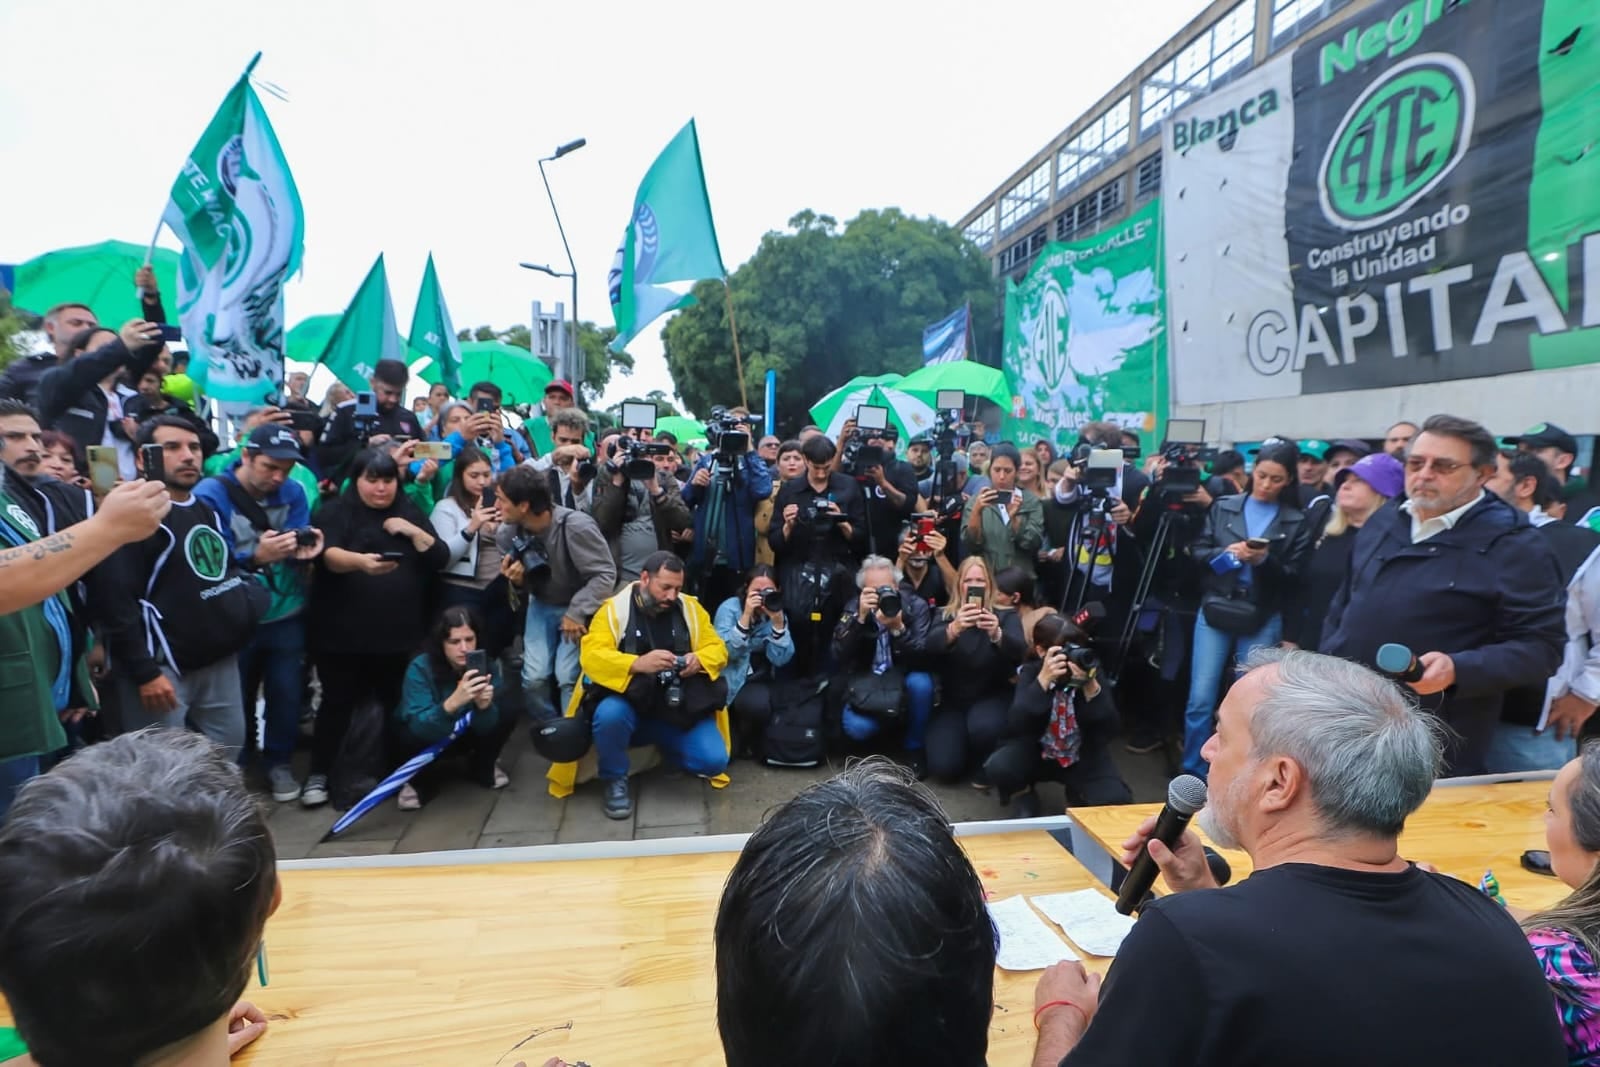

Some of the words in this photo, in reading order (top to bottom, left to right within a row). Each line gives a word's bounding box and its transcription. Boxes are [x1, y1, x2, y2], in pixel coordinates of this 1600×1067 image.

[1320, 0, 1470, 86] Neg
[1172, 88, 1280, 152] Blanca
[1340, 84, 1443, 206] ATE
[1307, 203, 1471, 272] Construyendo
[1330, 260, 1350, 287] la
[1353, 236, 1437, 279] Unidad
